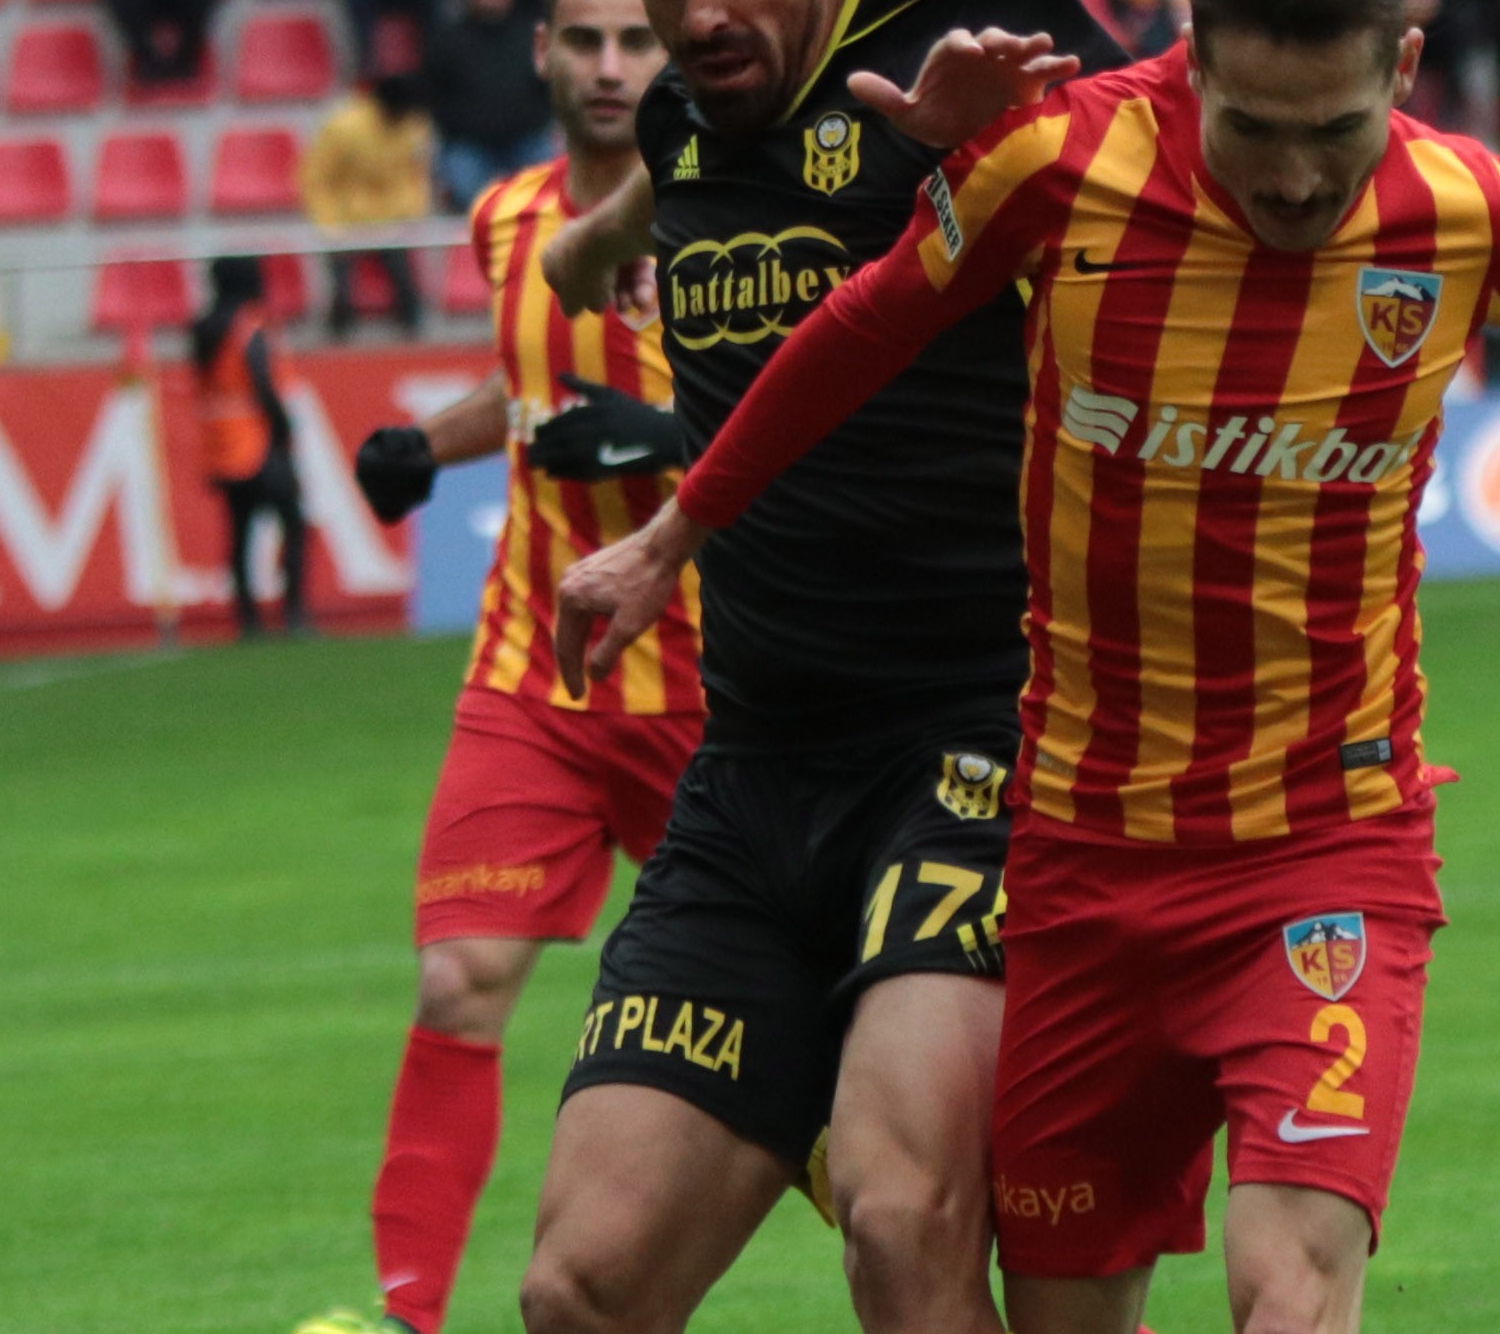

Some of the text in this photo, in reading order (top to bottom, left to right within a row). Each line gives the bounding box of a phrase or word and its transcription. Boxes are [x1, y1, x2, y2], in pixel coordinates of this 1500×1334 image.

[614, 994, 745, 1083] PLAZA
[1306, 1003, 1368, 1121] 2
[994, 1173, 1096, 1227] kaya
